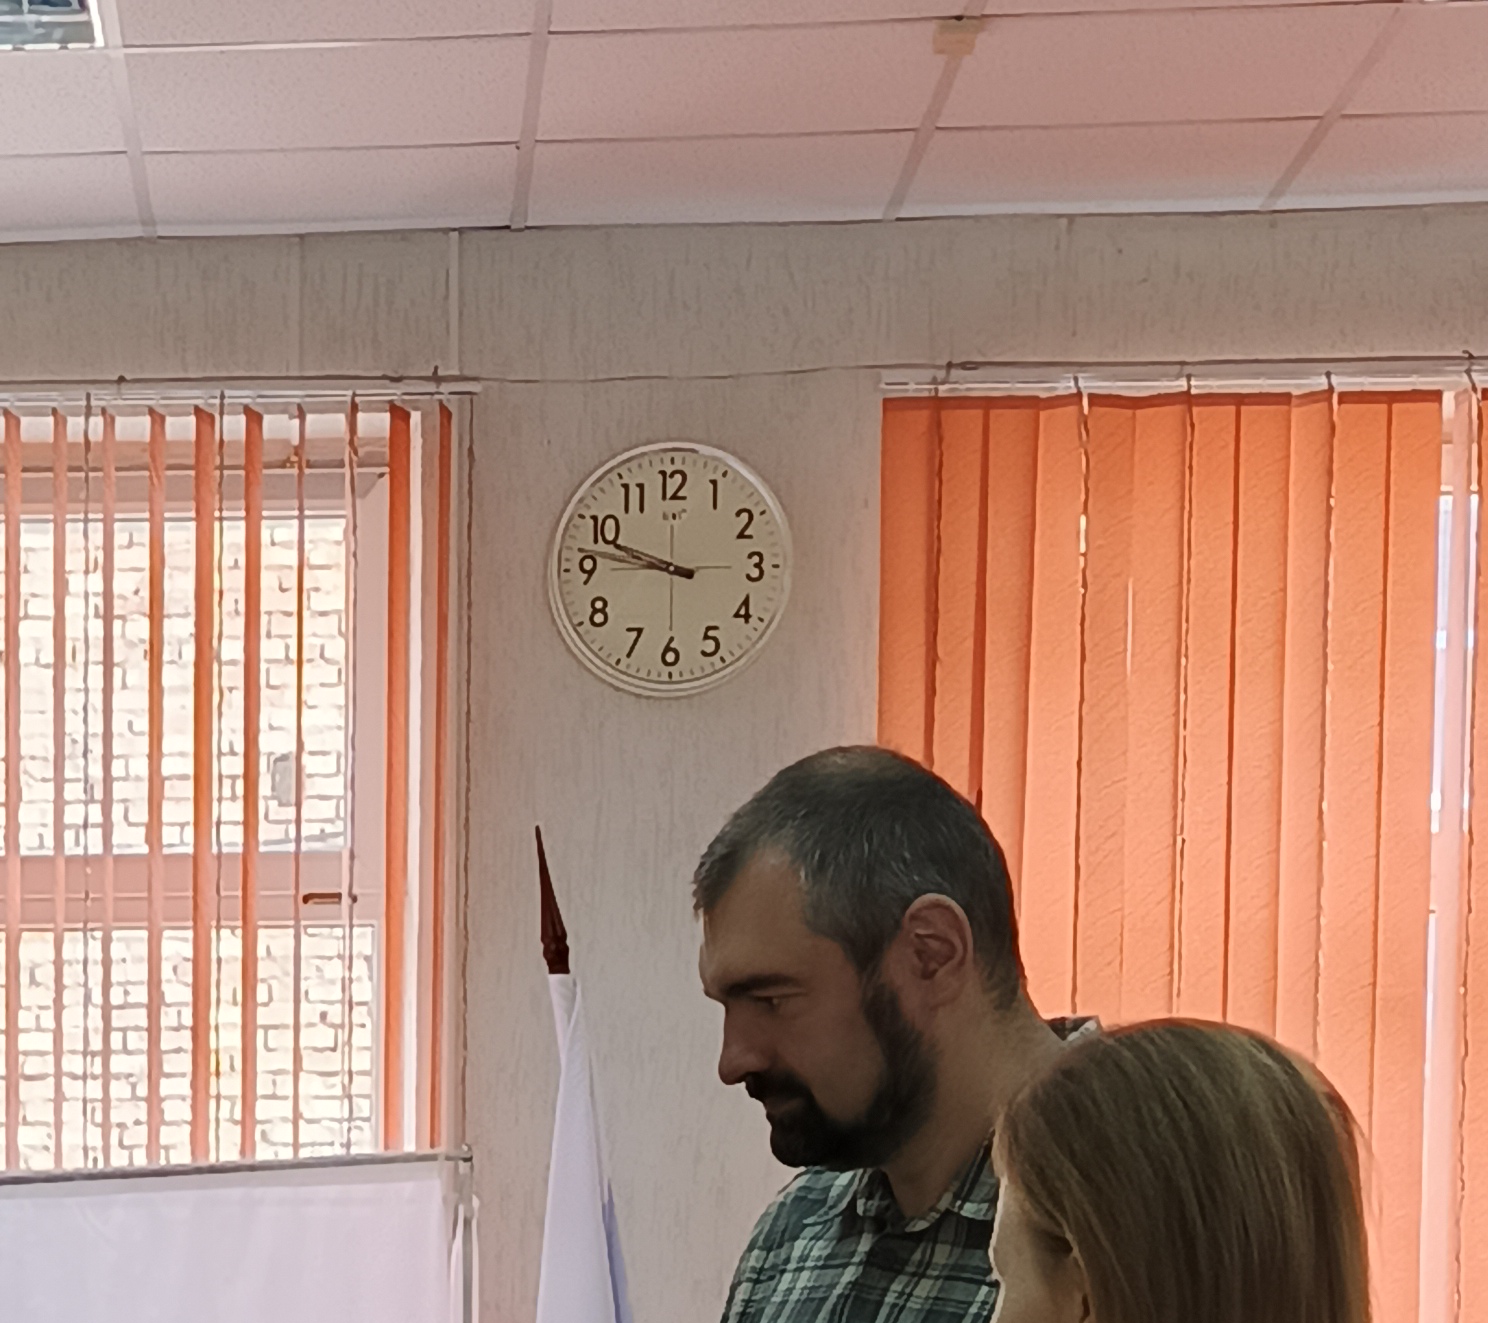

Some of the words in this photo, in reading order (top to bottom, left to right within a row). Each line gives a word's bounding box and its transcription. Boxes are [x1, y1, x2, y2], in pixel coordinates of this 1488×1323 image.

[620, 483, 645, 514] 11
[658, 469, 688, 501] 12
[709, 479, 718, 510] 1
[589, 514, 620, 545] 10
[735, 508, 754, 540] 2
[578, 554, 598, 585] 9
[745, 551, 765, 582] 3
[588, 596, 609, 627] 8
[732, 593, 752, 624] 4
[625, 627, 644, 658] 7
[661, 636, 680, 667] 6
[700, 625, 721, 657] 5
